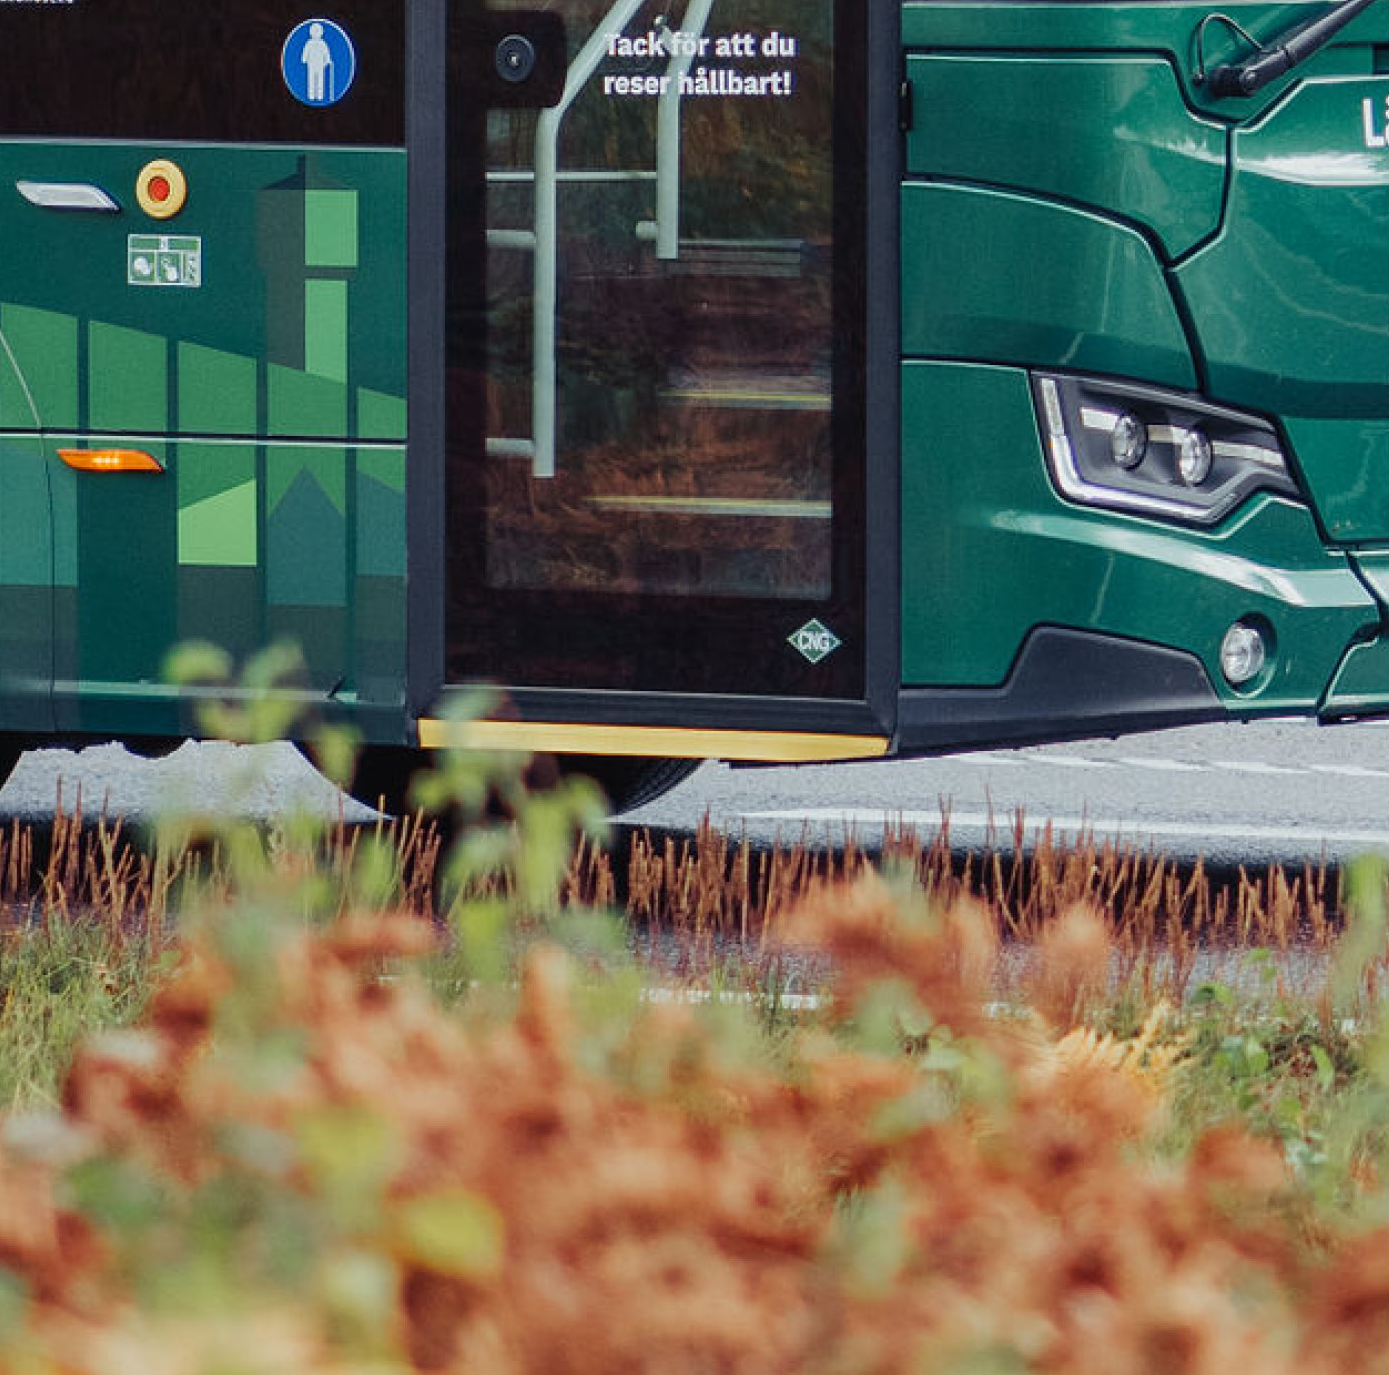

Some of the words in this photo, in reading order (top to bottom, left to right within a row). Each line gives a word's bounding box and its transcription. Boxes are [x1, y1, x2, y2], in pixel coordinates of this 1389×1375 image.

[604, 31, 665, 58] Tack
[669, 31, 709, 58] för
[715, 32, 756, 58] att
[763, 31, 796, 58] du
[603, 73, 672, 96] reser
[677, 67, 793, 96] hållbart!
